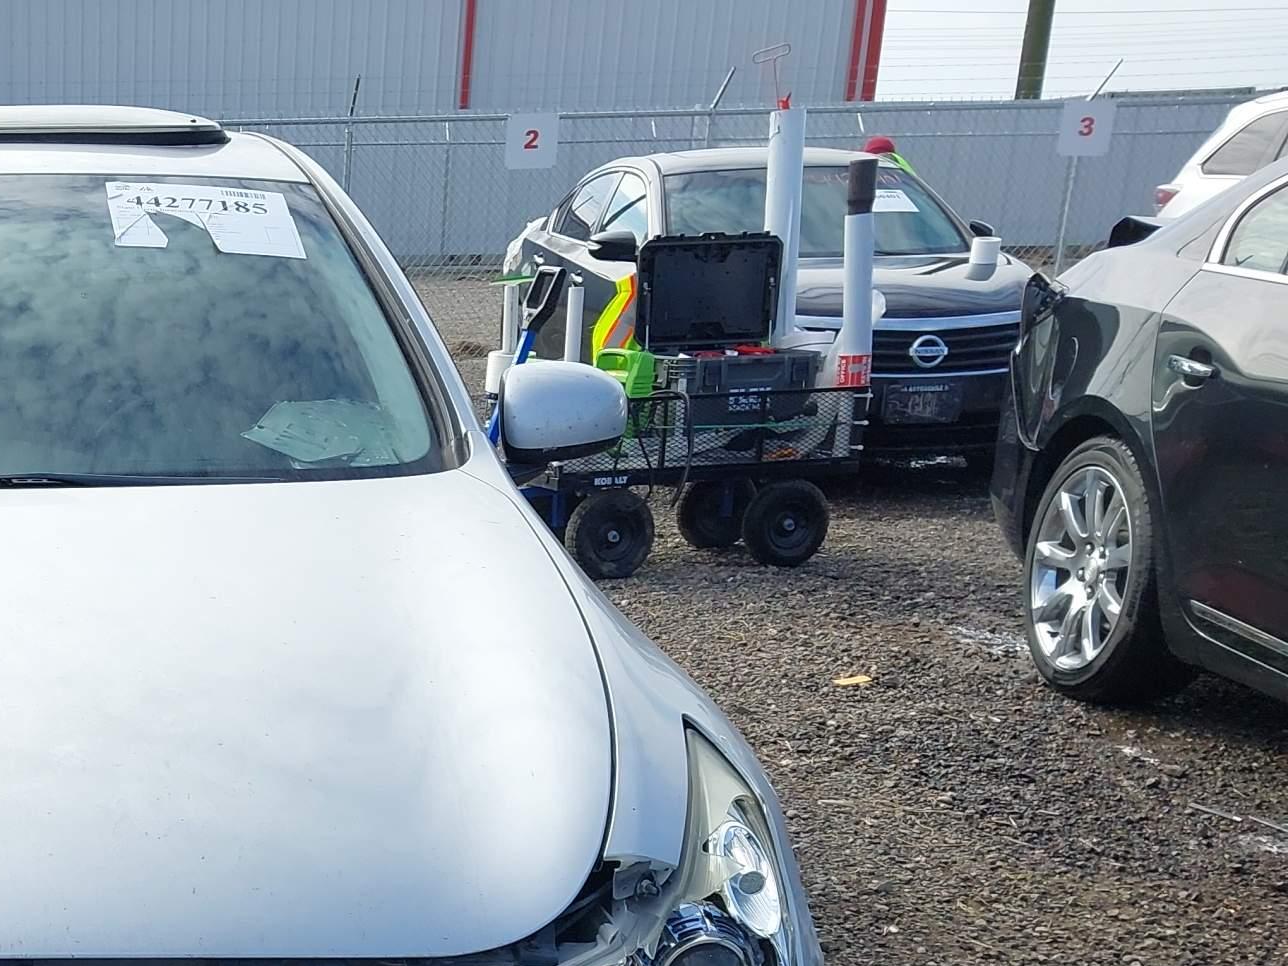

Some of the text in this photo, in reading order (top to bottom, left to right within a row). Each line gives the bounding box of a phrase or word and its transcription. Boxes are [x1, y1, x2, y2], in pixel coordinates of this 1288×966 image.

[1078, 116, 1095, 137] 3
[523, 129, 539, 150] 2
[126, 195, 268, 215] 44277185
